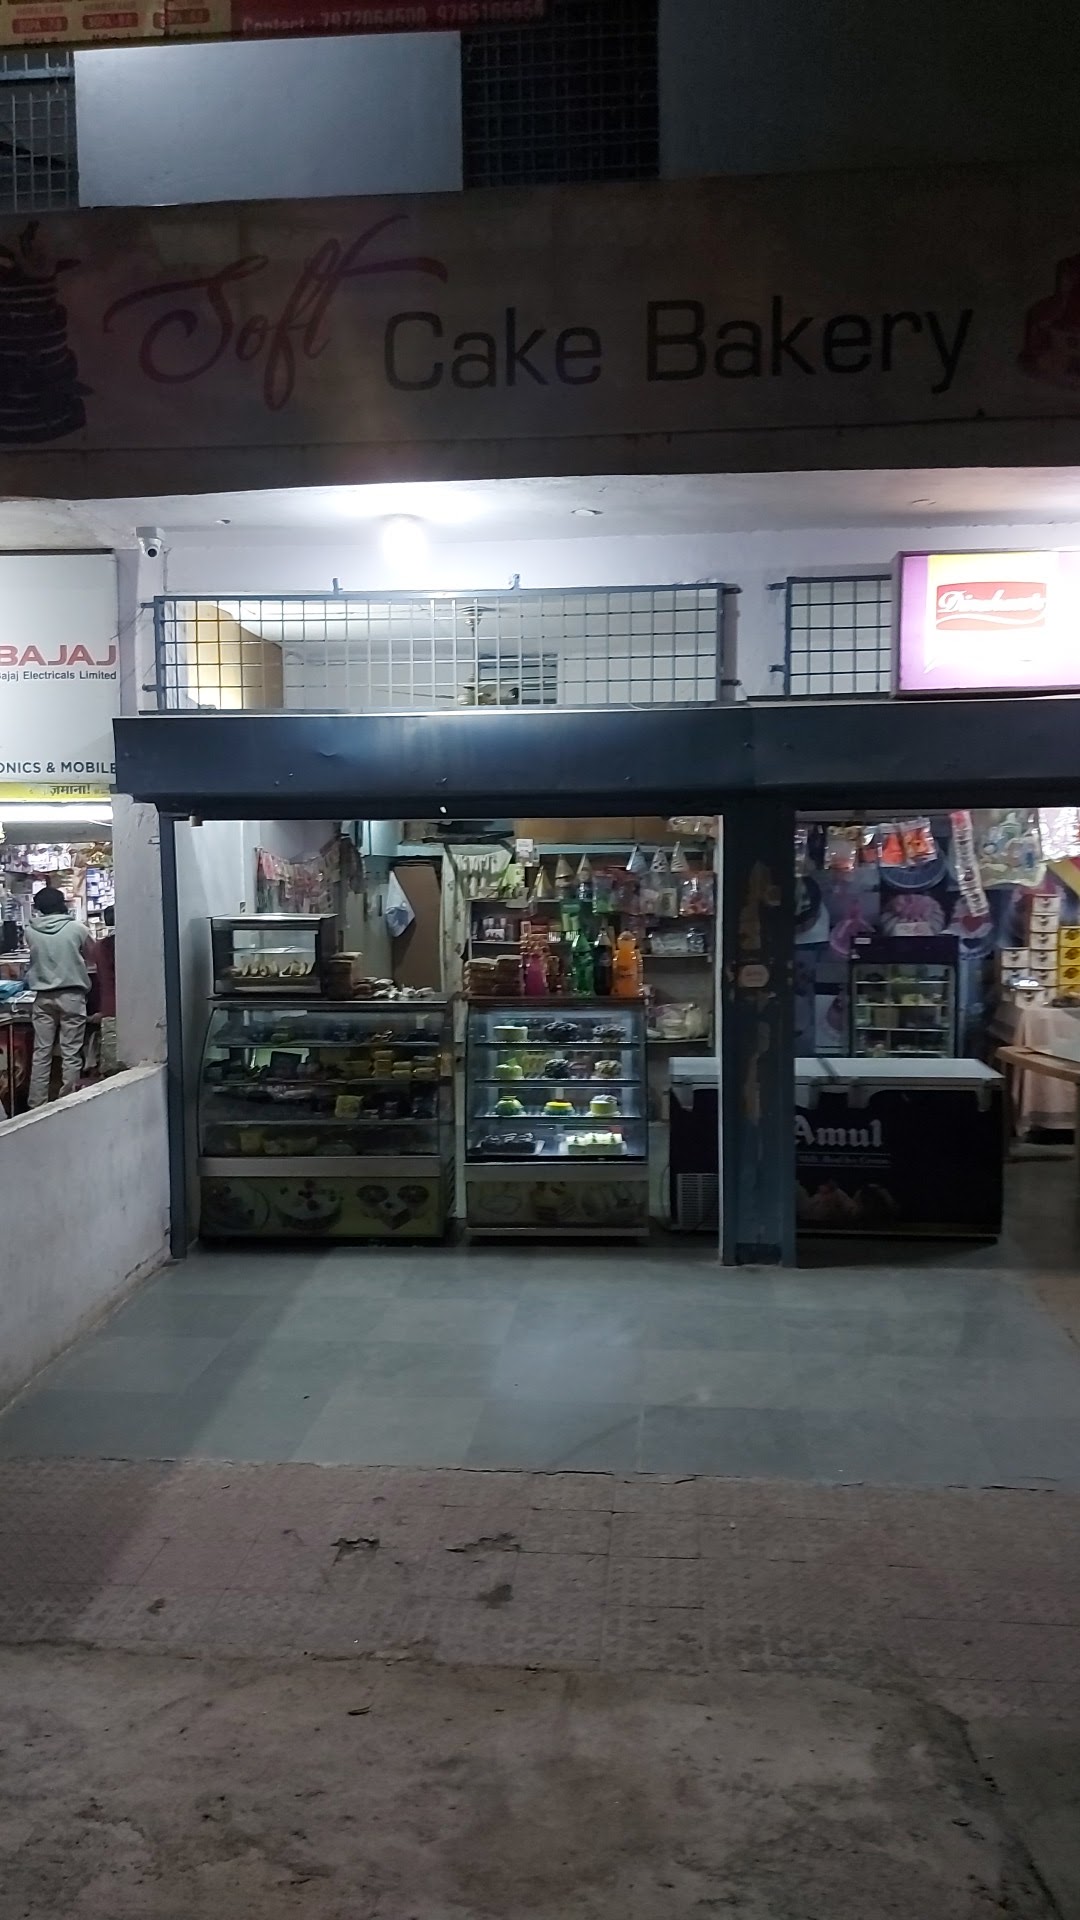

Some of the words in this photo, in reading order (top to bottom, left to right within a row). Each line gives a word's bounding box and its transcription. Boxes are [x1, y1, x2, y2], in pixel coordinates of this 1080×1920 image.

[103, 215, 447, 411] Soft
[384, 307, 602, 391] Cake
[646, 294, 973, 396] Bakery
[0, 644, 117, 667] BAJAJ
[0, 671, 19, 682] ajaj
[23, 670, 76, 680] Electricals
[79, 670, 117, 680] Limited
[46, 762, 55, 773] &
[793, 1114, 883, 1148] Amul
